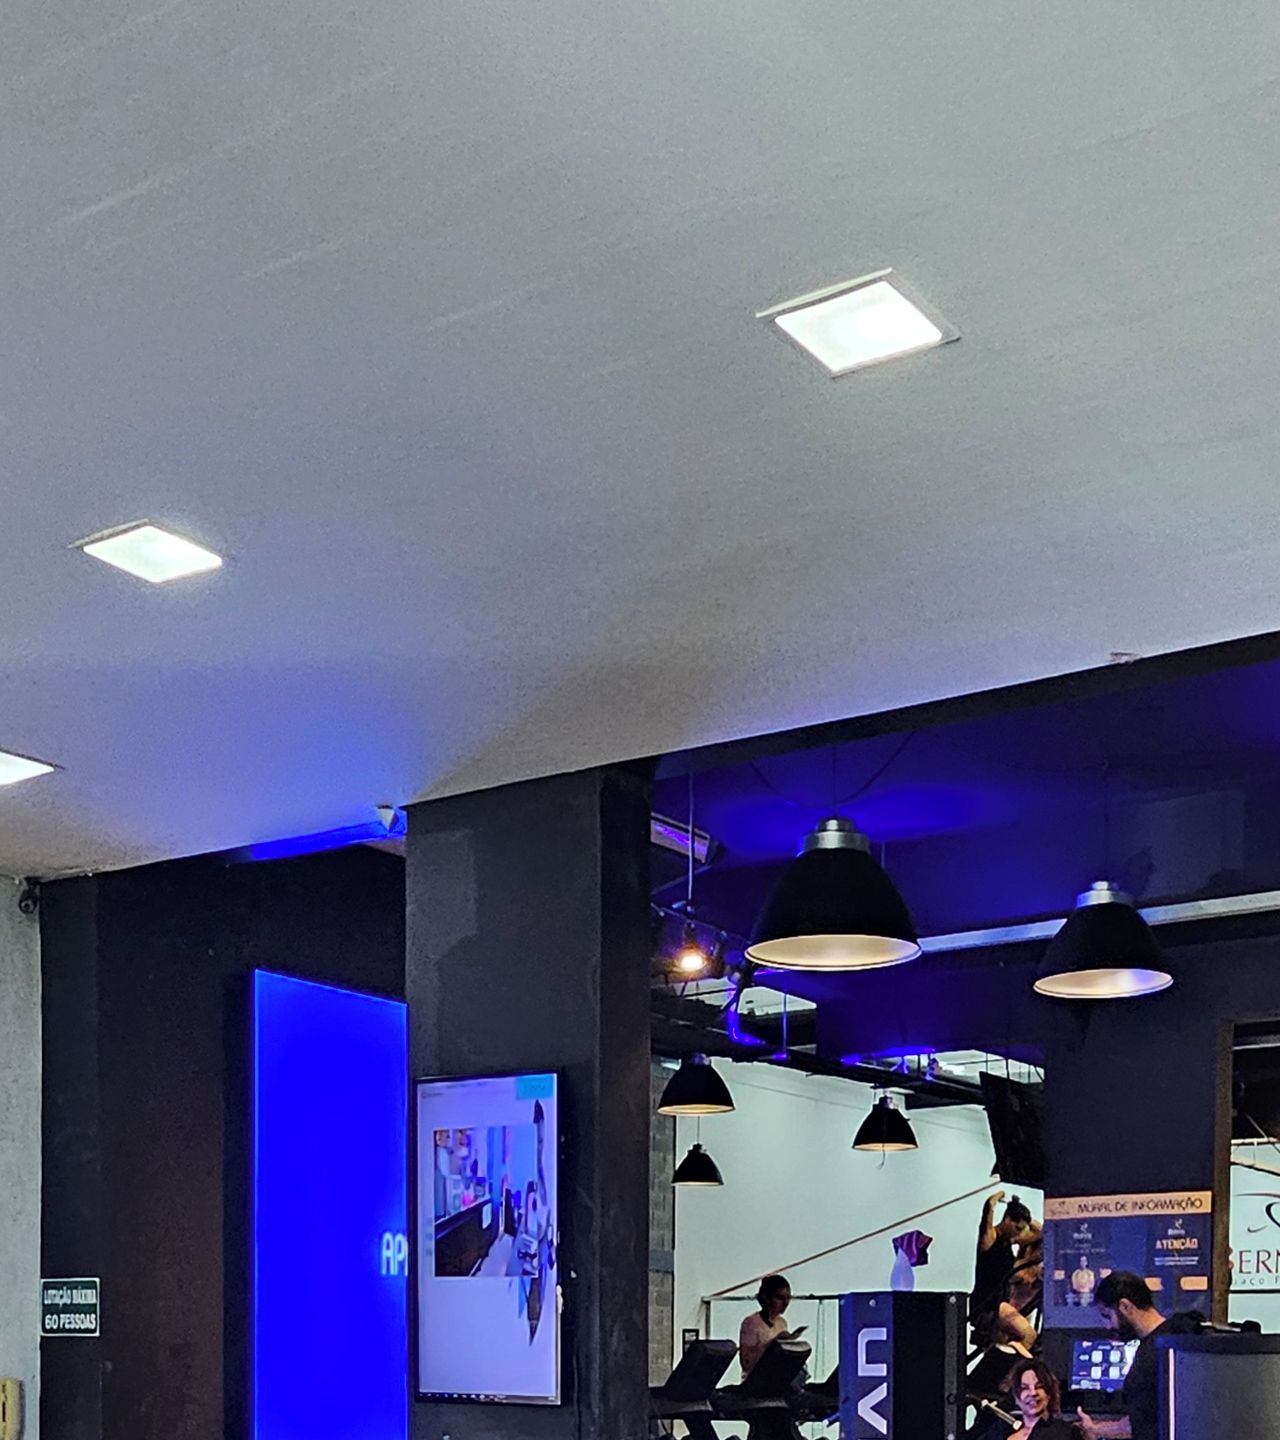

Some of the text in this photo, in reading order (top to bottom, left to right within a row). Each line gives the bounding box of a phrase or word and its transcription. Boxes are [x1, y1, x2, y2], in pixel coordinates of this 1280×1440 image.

[1077, 1201, 1112, 1214] MURAL
[1114, 1200, 1127, 1212] DE
[1131, 1197, 1203, 1211] INFORMAÇÃO
[1155, 1238, 1199, 1250] ATENÇÃO
[381, 1231, 408, 1277] AP
[45, 1313, 96, 1330] 60 PESSOAS
